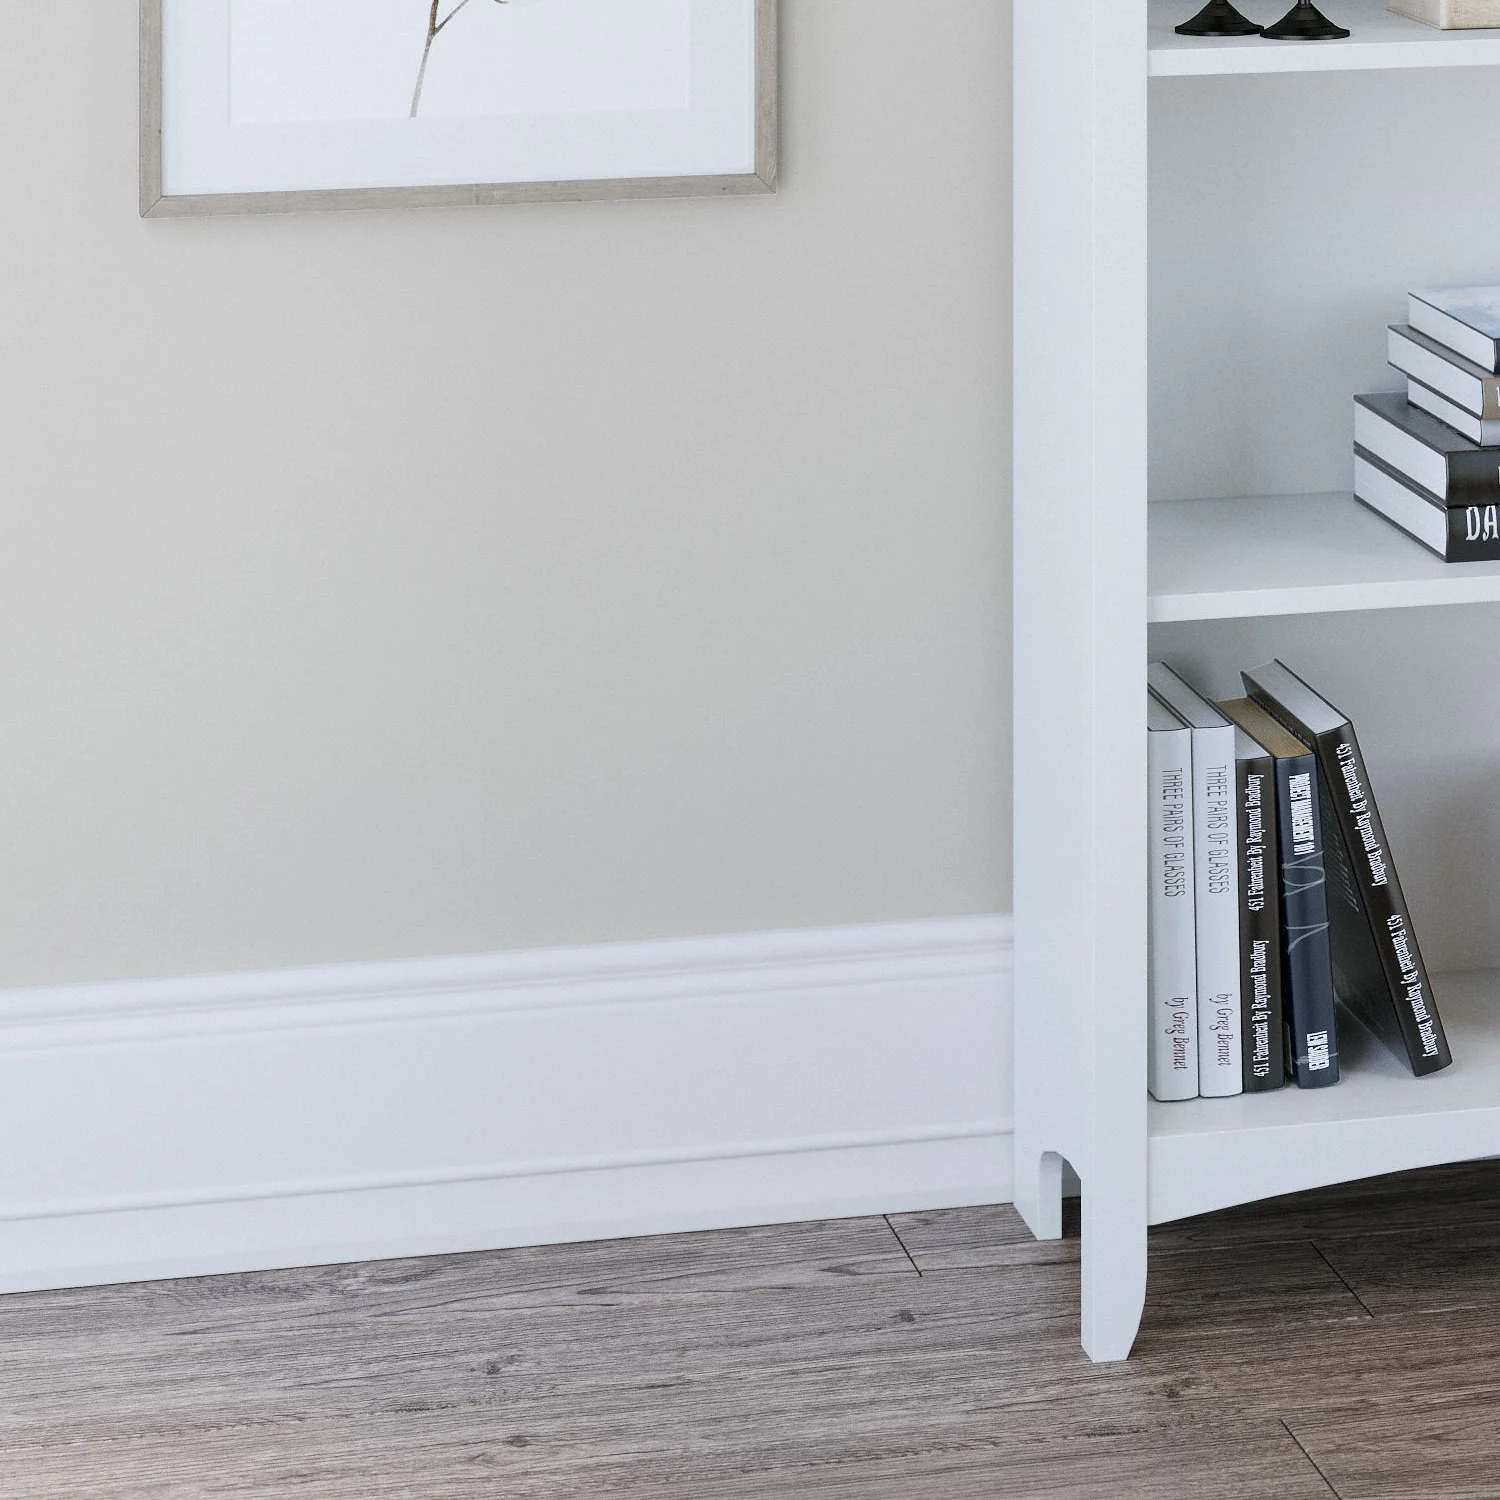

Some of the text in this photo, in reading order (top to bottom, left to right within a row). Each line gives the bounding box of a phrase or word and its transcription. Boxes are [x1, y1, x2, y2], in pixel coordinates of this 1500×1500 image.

[1162, 767, 1186, 897] THREE PAIRS OF GLASSES
[1206, 765, 1230, 894] THREE PAIRS OF GLASSES
[1245, 774, 1267, 911] 451 Fahrenheit By Raymond Bradbury
[1293, 841, 1316, 856] 101
[1335, 743, 1388, 887] 451 Fahrenheit By Raymond Bradbury
[1165, 997, 1190, 1070] by Greg Bennet
[1209, 993, 1234, 1066] by Greg Bennet
[1250, 940, 1272, 1077] 451 Fahrenheit By Raymond Bradbury
[1387, 914, 1439, 1057] 451 Fahrenheit By Raymond Bradbury
